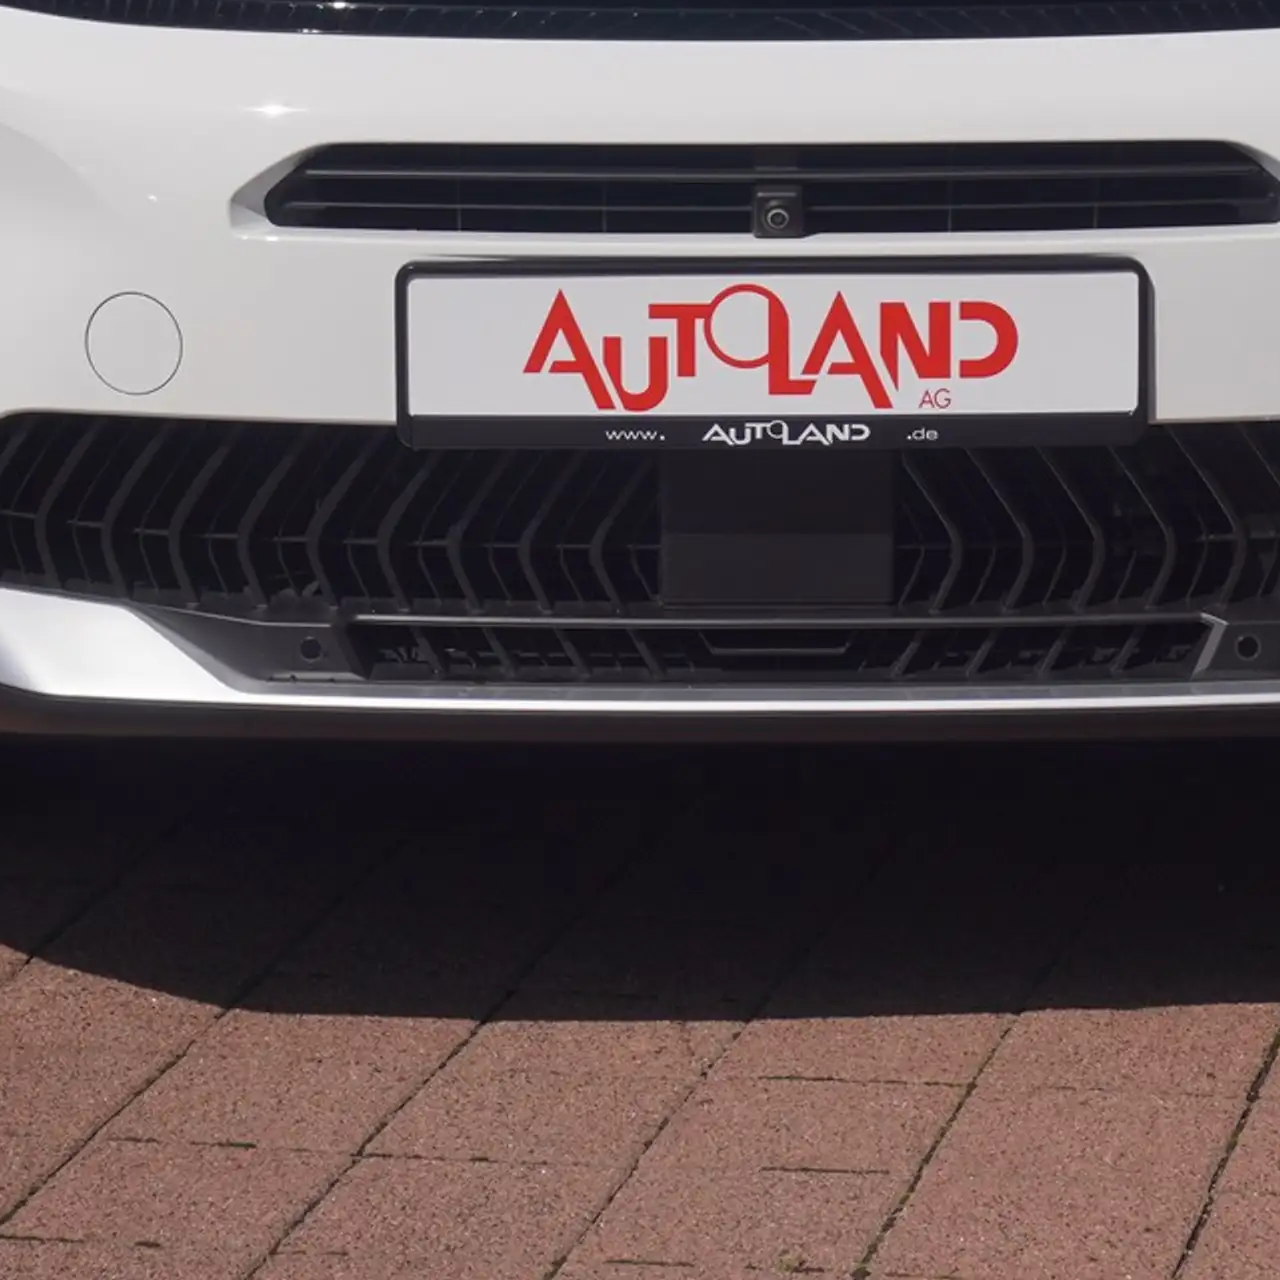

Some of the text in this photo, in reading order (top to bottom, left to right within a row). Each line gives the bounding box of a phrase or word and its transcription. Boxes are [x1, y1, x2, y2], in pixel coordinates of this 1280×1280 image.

[522, 282, 1019, 412] AUTOLAND
[917, 387, 952, 409] AG
[605, 419, 939, 446] www. AUTOLAND .de
